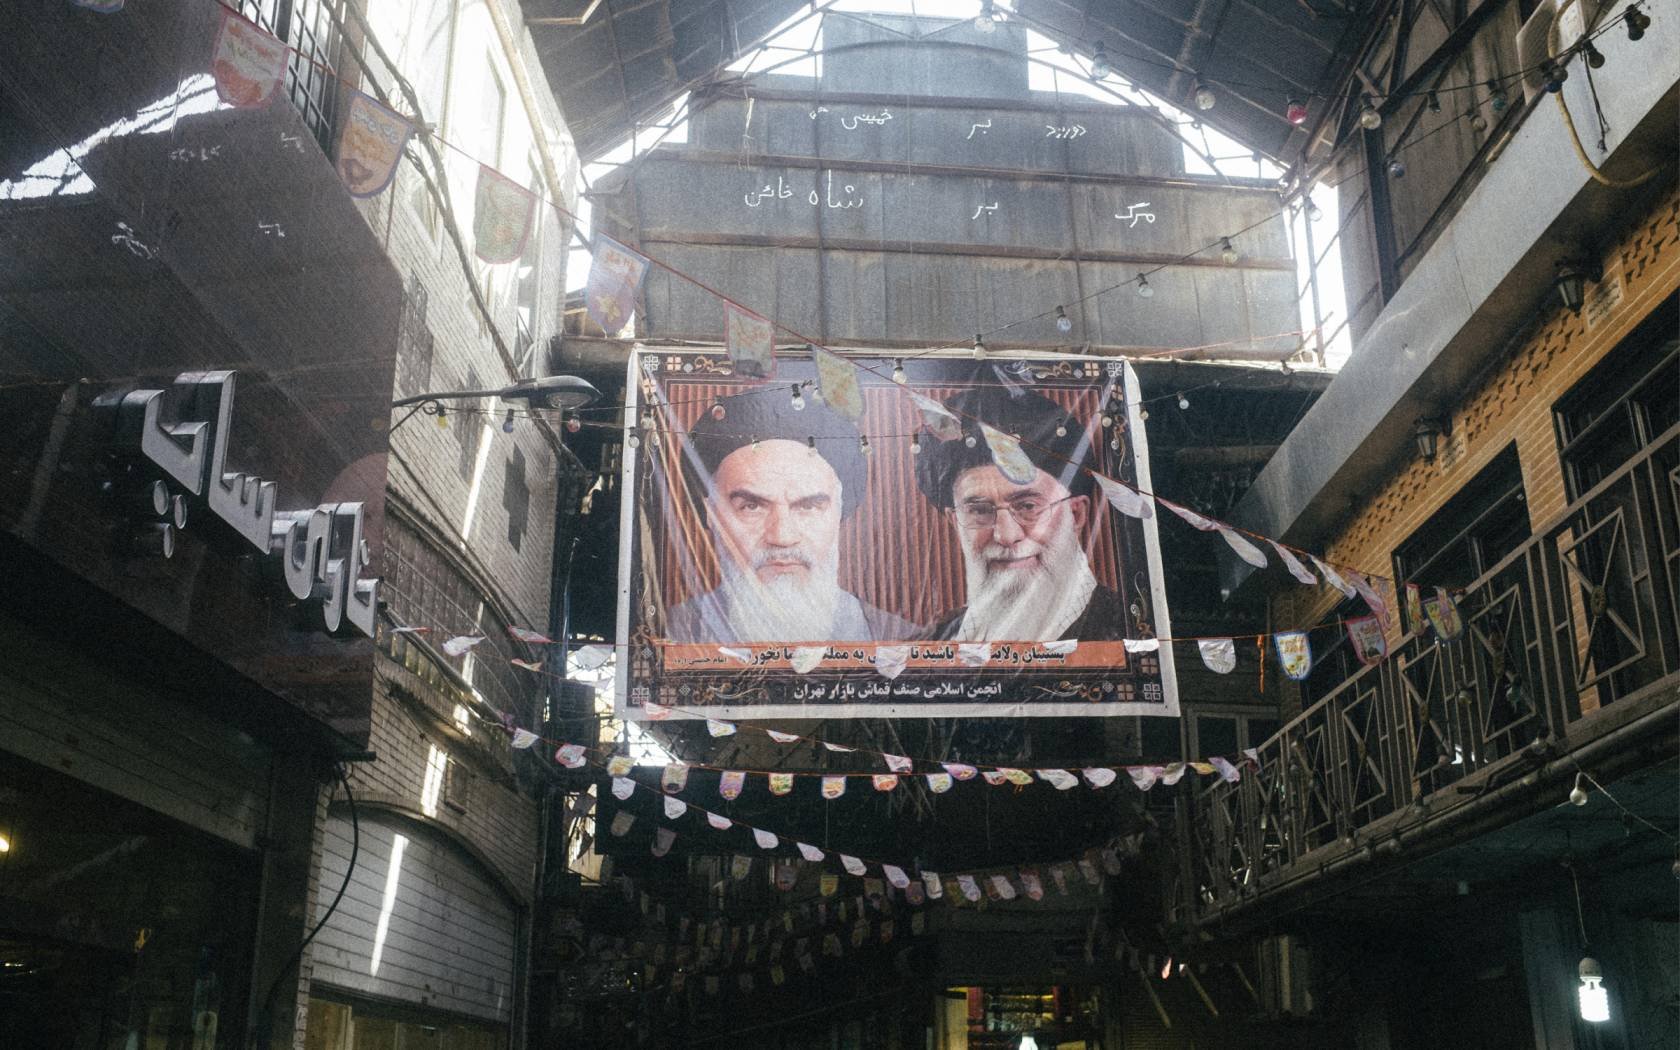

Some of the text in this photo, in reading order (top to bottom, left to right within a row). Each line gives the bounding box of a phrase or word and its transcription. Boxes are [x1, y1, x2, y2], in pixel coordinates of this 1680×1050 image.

[840, 108, 894, 130] خمینی
[966, 119, 992, 140] بر
[744, 169, 1156, 229] مرگ بر شاه خائن
[852, 648, 863, 663] به
[910, 646, 920, 660] تا
[923, 645, 954, 664] باشید
[793, 681, 1002, 700] انجمن اسلامی صنف قماش بازار تهران
